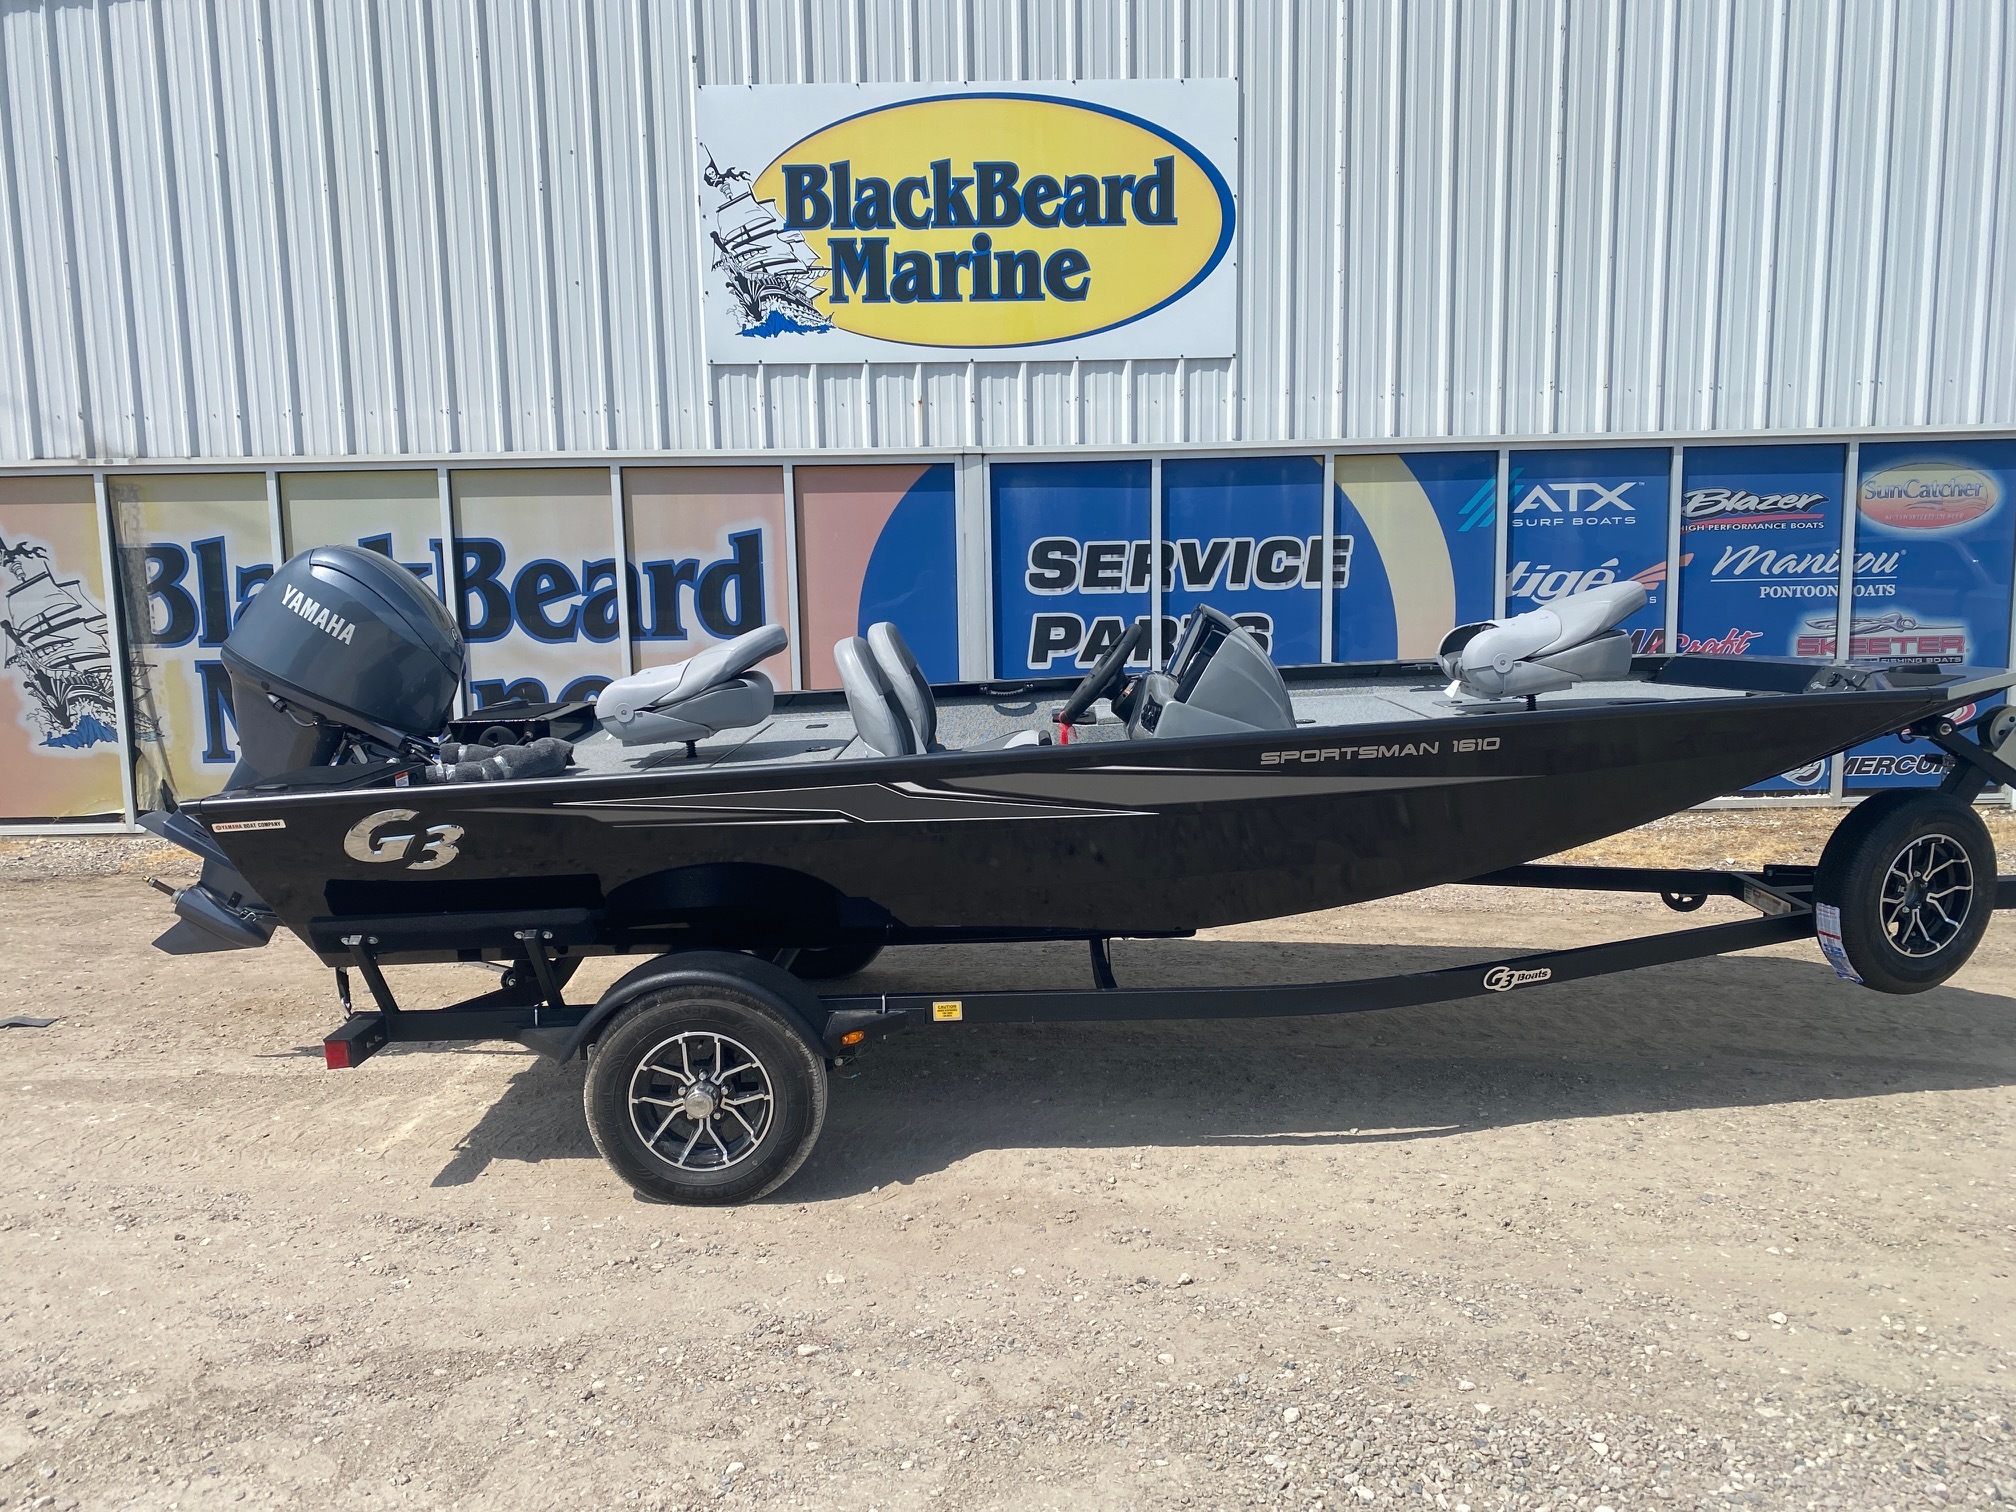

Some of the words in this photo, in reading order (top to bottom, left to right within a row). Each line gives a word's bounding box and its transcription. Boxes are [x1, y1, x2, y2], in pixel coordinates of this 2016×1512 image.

[782, 155, 1178, 231] BlackBeard
[827, 232, 1092, 304] Marine
[1512, 482, 1637, 513] ATX
[1681, 488, 1830, 520] Blazer
[1864, 479, 1984, 500] SunCatcher
[1512, 518, 1564, 527] SURF
[1572, 516, 1636, 526] BOATS
[1708, 522, 1787, 531] PERFORMANCE
[1791, 521, 1824, 530] BOATS
[1025, 537, 1354, 595] SERVICE
[1711, 545, 1900, 576] Maniou
[1759, 585, 1839, 598] PONTOON
[1852, 584, 1896, 597] OATS
[281, 584, 356, 646] YAMAHA
[1028, 613, 1273, 669] PARS
[1797, 635, 1965, 656] SKEETER
[1260, 742, 1440, 765] SPORTSMAN
[1452, 737, 1501, 753] 1610
[343, 808, 465, 871] G3
[1484, 967, 1515, 990] G3
[1517, 970, 1548, 981] Boats
